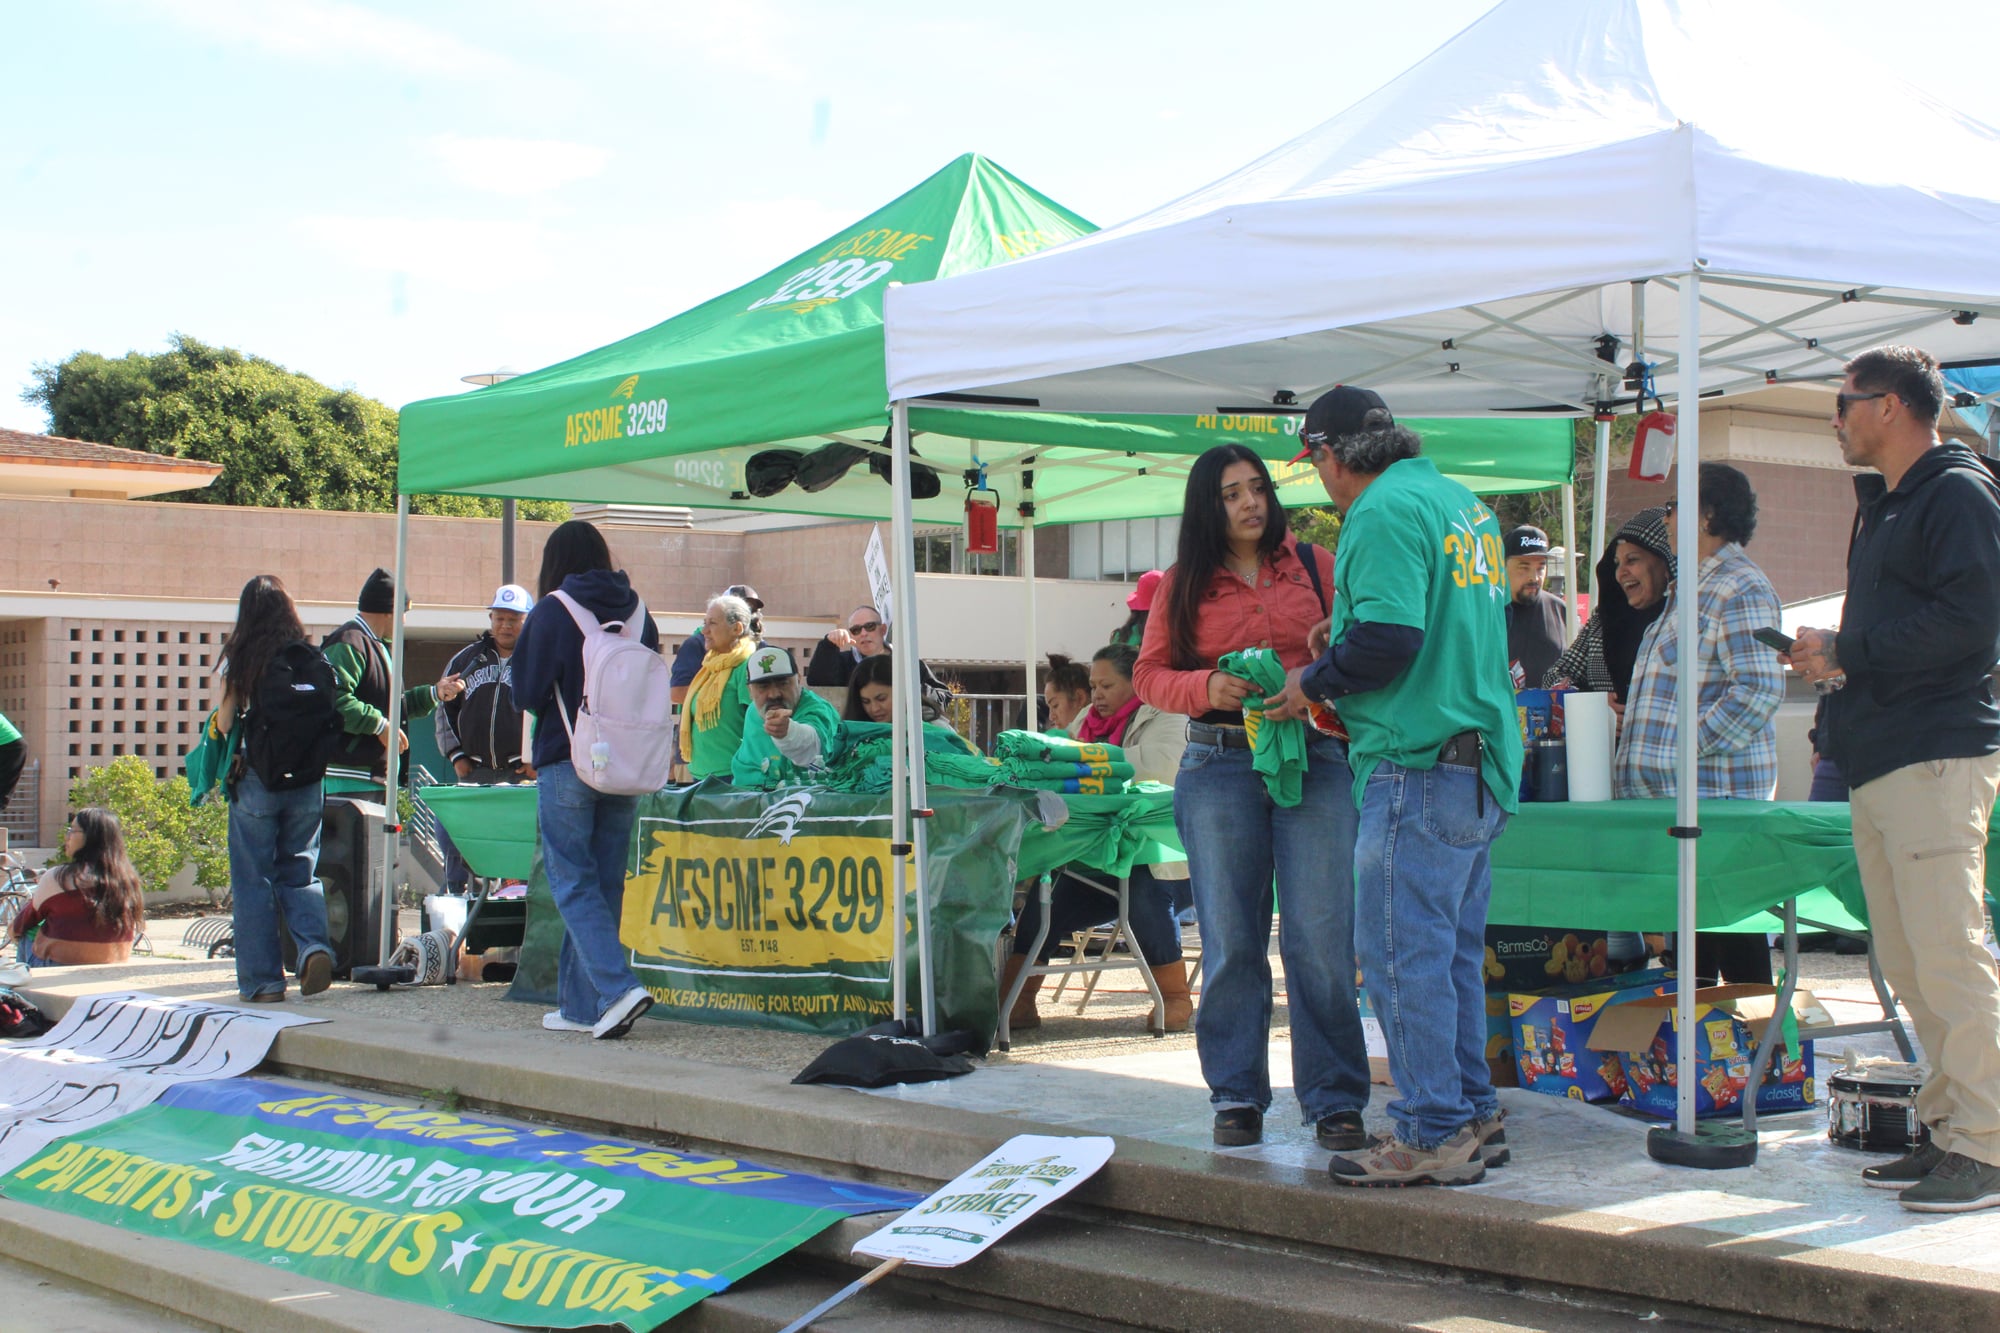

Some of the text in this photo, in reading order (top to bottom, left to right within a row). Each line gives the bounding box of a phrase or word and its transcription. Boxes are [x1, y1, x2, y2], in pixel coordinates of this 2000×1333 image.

[565, 398, 668, 448] AFSCME 3299
[650, 855, 885, 934] AFSCME 3299
[740, 938, 778, 953] EST. 148
[1497, 938, 1548, 953] FarmsCo
[645, 986, 704, 1008] WORKERS
[707, 990, 765, 1013] FIGHTING
[768, 993, 791, 1013] FOR
[792, 995, 841, 1017] EQUITY
[843, 994, 867, 1012] AND
[1766, 1085, 1801, 1101] classic
[971, 1163, 1077, 1179] AFSCME 3299
[203, 1133, 625, 1234] FIGHTING FOR OUR
[985, 1178, 1019, 1191] ON
[14, 1142, 215, 1219] PATIENTS
[214, 1185, 463, 1276] STUDENTS
[920, 1193, 1037, 1215] STRIKE!
